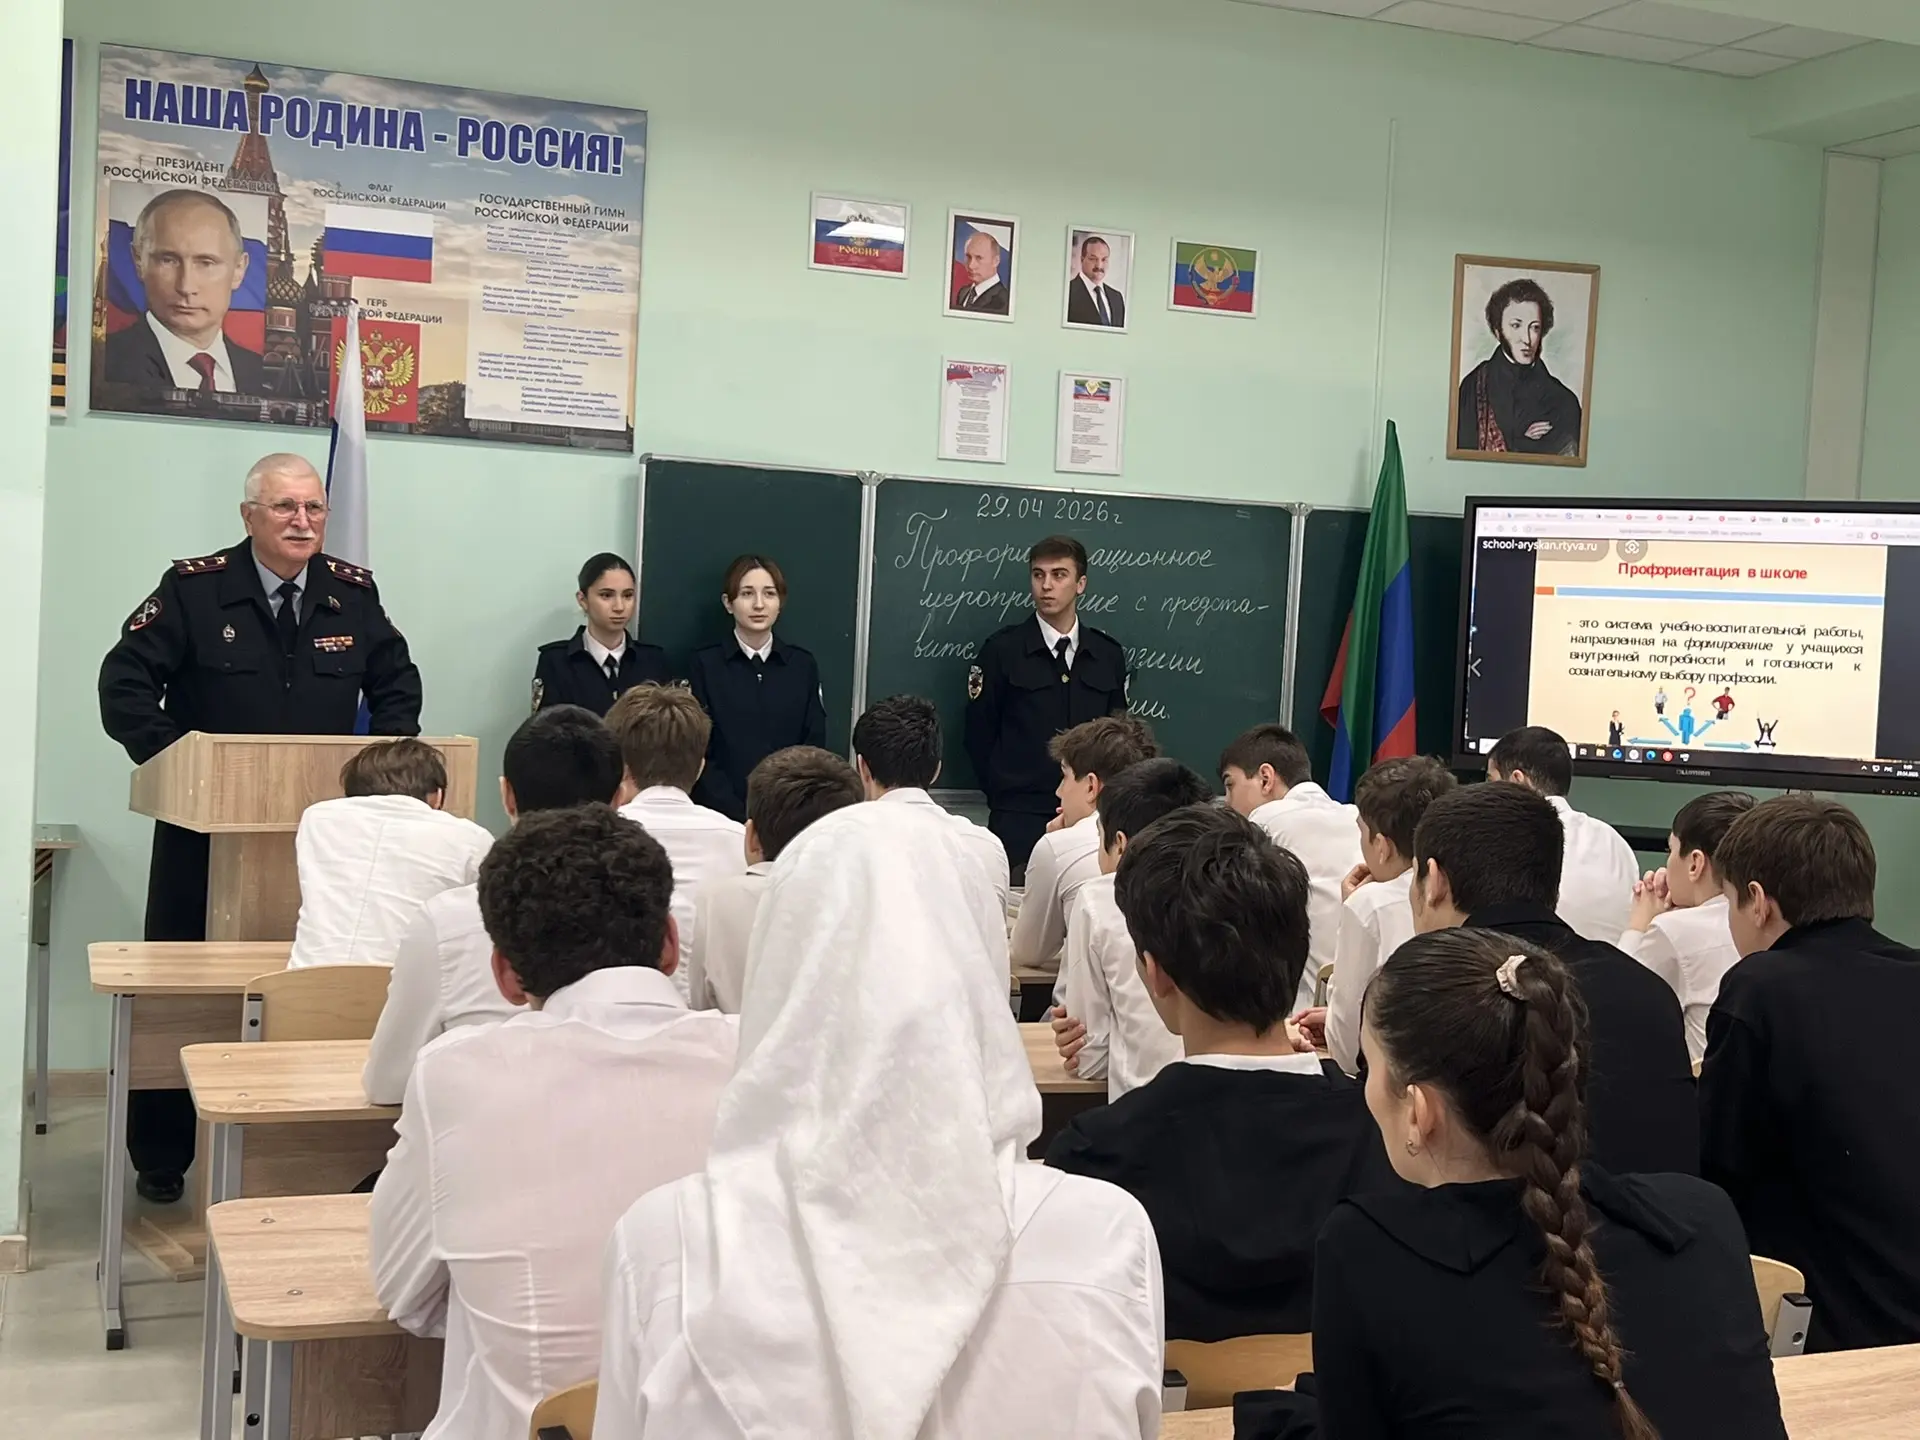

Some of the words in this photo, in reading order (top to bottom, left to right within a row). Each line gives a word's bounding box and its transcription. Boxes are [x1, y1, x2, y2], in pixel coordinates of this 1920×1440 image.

[124, 78, 249, 132] НАША
[259, 92, 425, 152] РОДИНА
[434, 132, 449, 143] -
[456, 116, 625, 176] РОССИЯ!
[156, 156, 224, 173] ПРЕЗИДЕНТ
[103, 165, 197, 185] РОССИЙСКОЙ
[201, 175, 276, 193] ФЕДЕРАЦИИ
[368, 183, 393, 192] ФЛАГ
[313, 188, 386, 203] РОССИЙСКОЙ
[388, 197, 446, 210] ФЕДЕРАЦИИ
[479, 193, 591, 215] ГОСУДАРСТВЕННЫЙ
[594, 206, 625, 218] ГИМН
[474, 207, 559, 225] РОССИЙСКОЙ
[563, 217, 629, 233] ФЕДЕРАЦИИ
[839, 245, 879, 257] РОССИЯ
[366, 298, 388, 307] ГЕРБ
[385, 311, 443, 324] ФЕДЕРАЦИИ
[977, 493, 1043, 518] 29.04
[895, 508, 1217, 592] Профориационное
[1482, 538, 1598, 553] school-aryskan.rtyva.ru
[1618, 562, 1740, 580] Профориентация
[1747, 568, 1757, 578] в
[1760, 567, 1808, 579] школе
[1135, 595, 1147, 612] с
[1160, 596, 1270, 630] предста-
[1578, 620, 1599, 629] это
[1604, 620, 1653, 631] система
[1660, 621, 1806, 635] учебно-воспитательной
[1813, 626, 1864, 640] работы,
[1570, 635, 1656, 647] направленная
[1662, 638, 1678, 648] на
[1684, 637, 1773, 652] формирование
[1786, 643, 1794, 655] у
[1800, 643, 1864, 656] учащихся
[1569, 650, 1640, 663] внутренней
[1649, 653, 1726, 666] потребности
[1745, 658, 1754, 667] и
[1763, 659, 1834, 670] готовности
[1854, 663, 1861, 672] к
[1568, 667, 1657, 682] сознательному
[1660, 670, 1706, 684] выбору
[1708, 672, 1777, 686] профессии.
